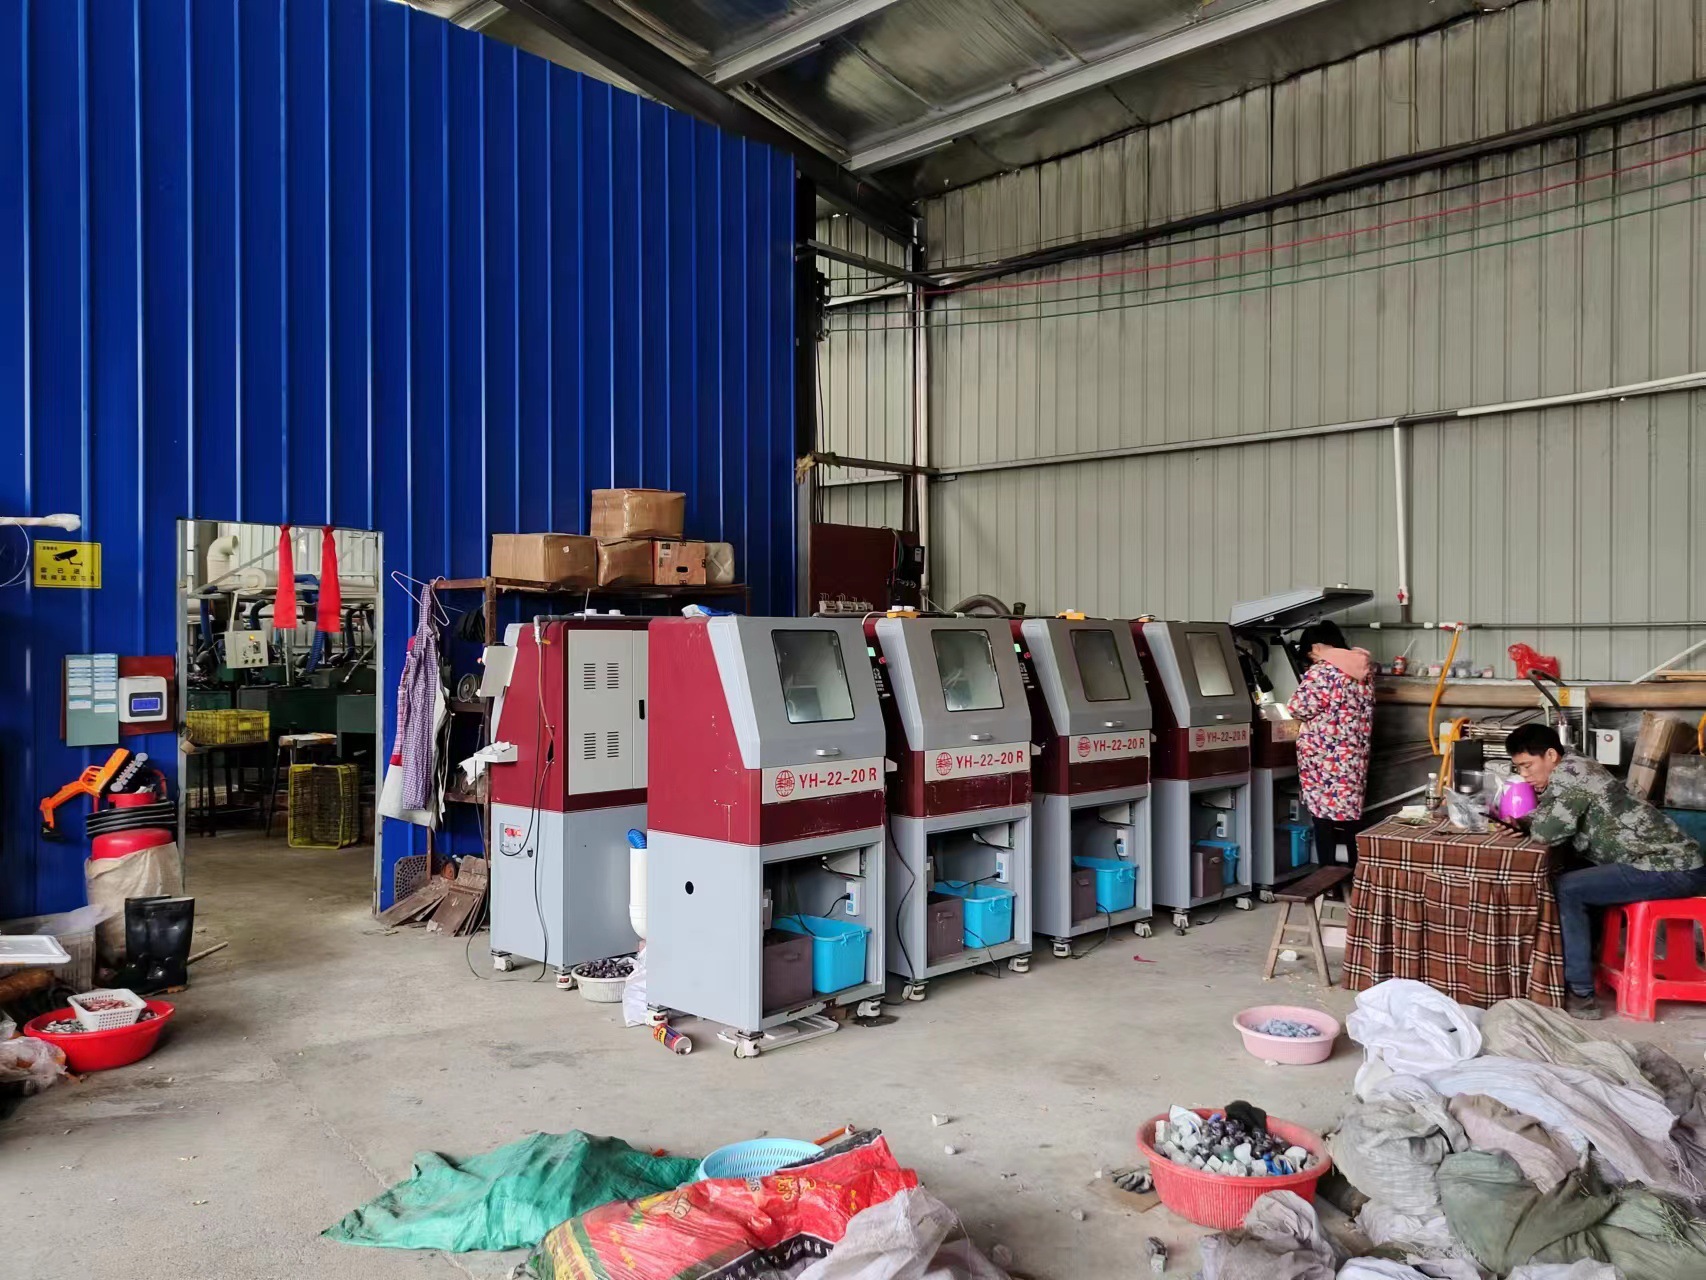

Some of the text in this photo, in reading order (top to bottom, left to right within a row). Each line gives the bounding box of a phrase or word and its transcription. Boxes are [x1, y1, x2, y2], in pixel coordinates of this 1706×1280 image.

[1093, 737, 1145, 752] YH-22-20 R
[1206, 729, 1247, 743] YH-22-20 R
[956, 750, 1024, 769] YH-22-20 R
[799, 767, 877, 789] YH-22-20 R
